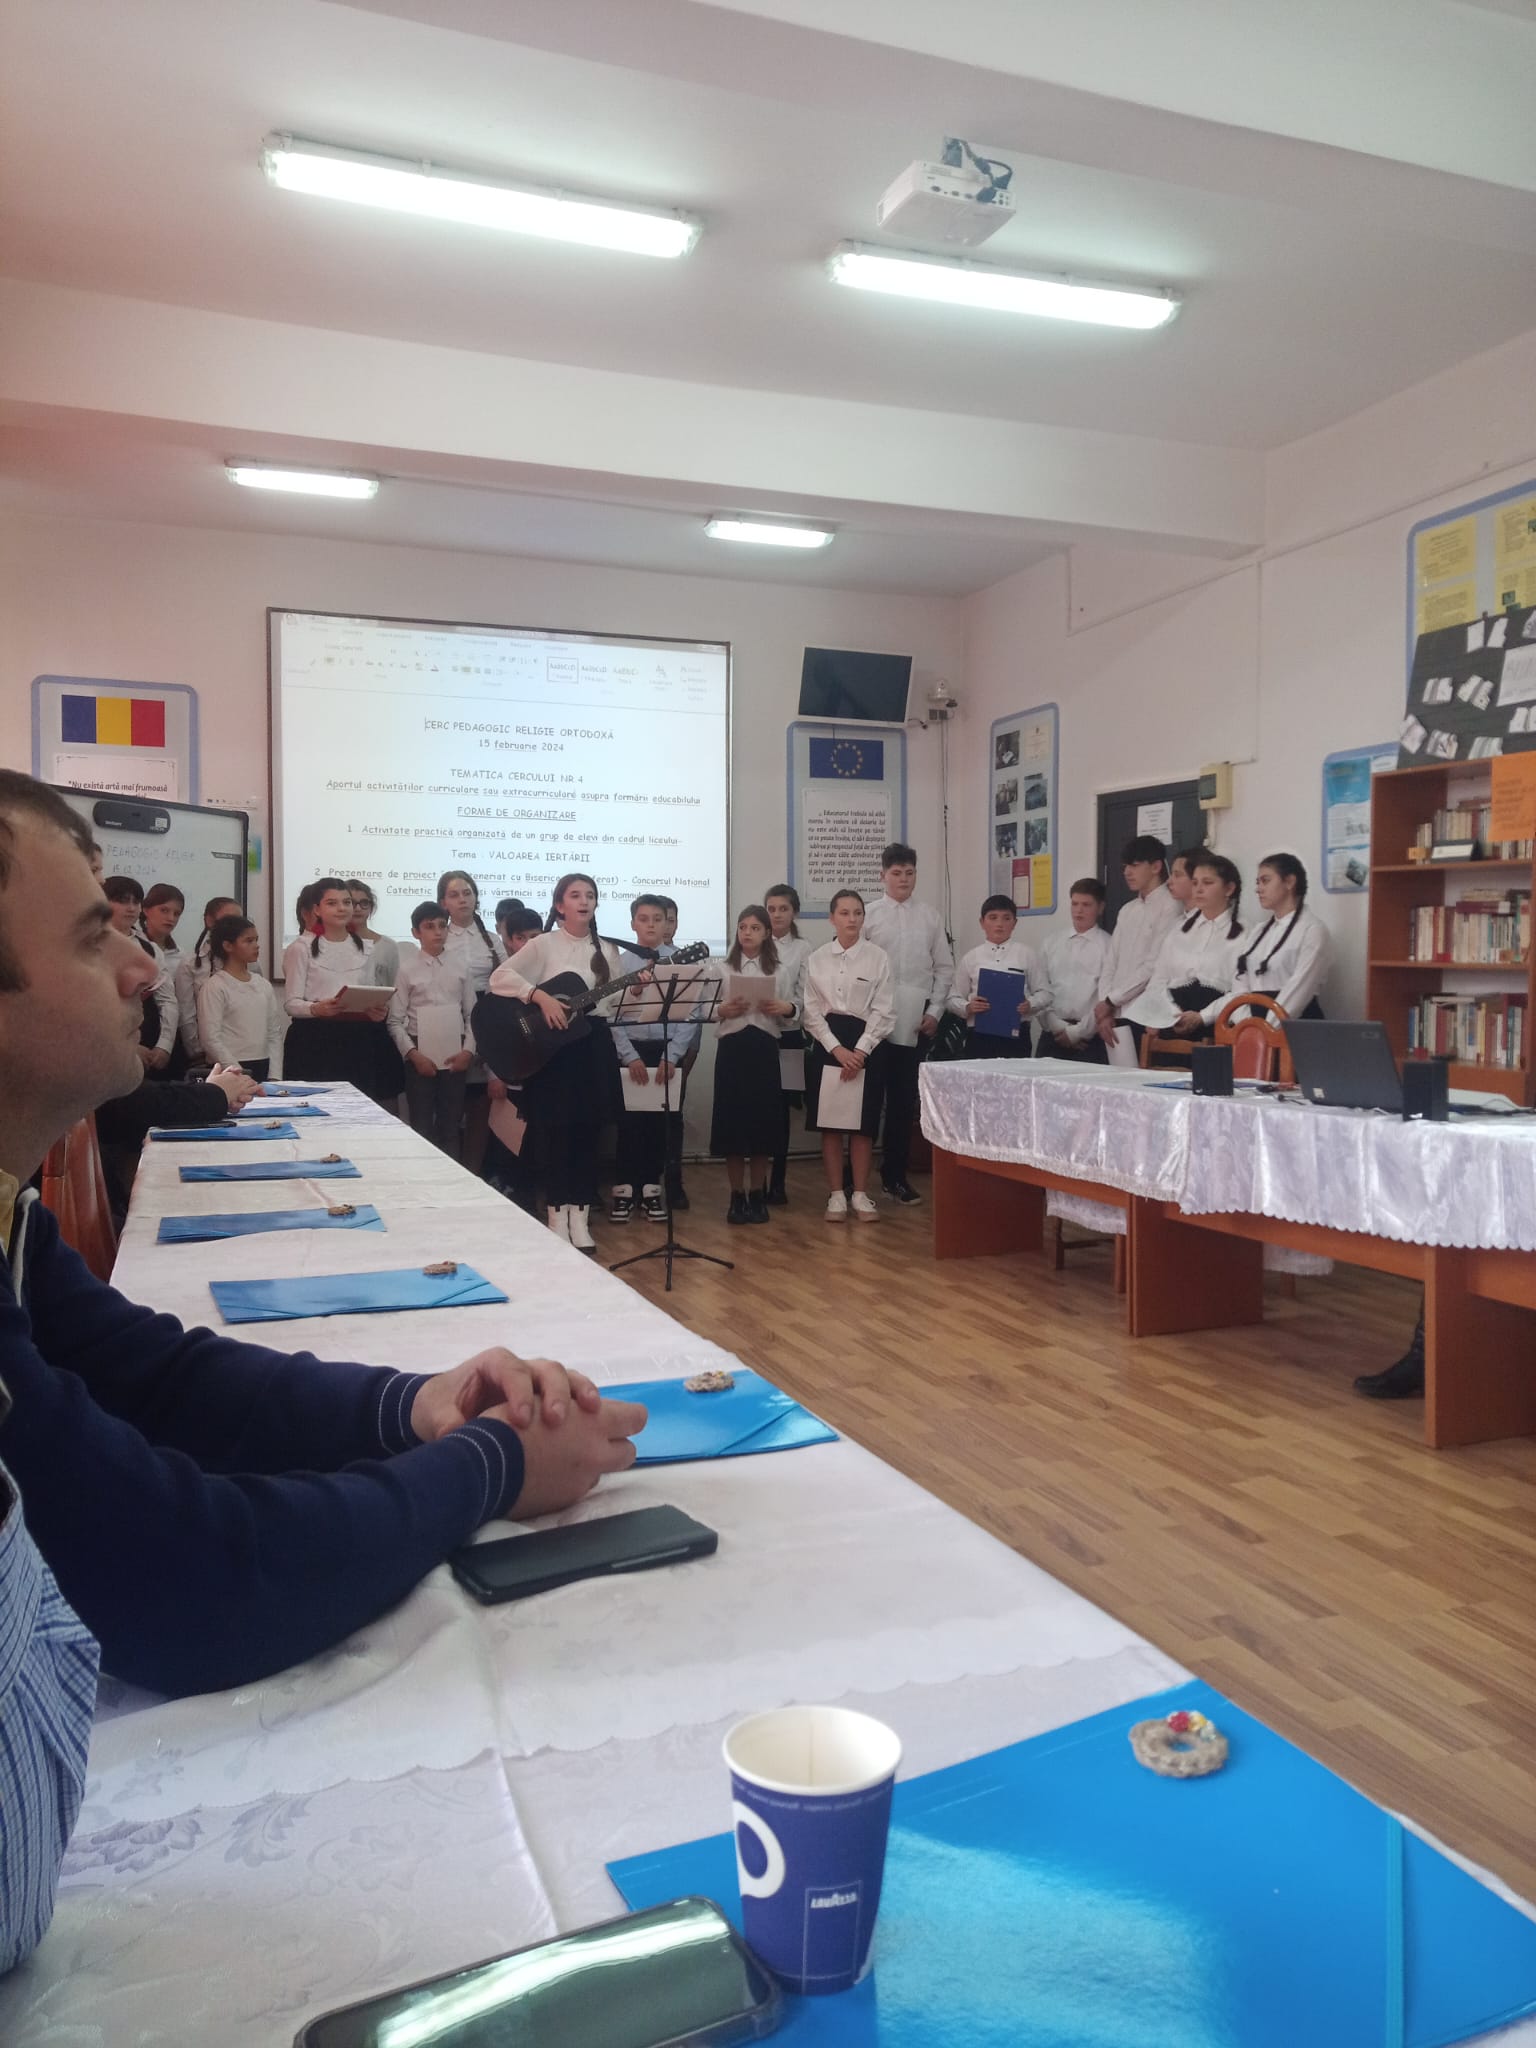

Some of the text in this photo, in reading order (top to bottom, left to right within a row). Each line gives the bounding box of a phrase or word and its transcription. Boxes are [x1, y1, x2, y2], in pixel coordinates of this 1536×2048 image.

[426, 720, 450, 730] CERC
[453, 721, 511, 734] PEDAGOGIC
[515, 725, 555, 736] RELIGIE
[479, 739, 564, 752] 15 februarie 2024
[450, 768, 503, 780] TEMATICA
[508, 771, 555, 783] CERCULUI
[135, 784, 168, 792] frumoasă
[327, 779, 362, 790] Aportul
[428, 784, 479, 795] curriculare
[483, 786, 499, 795] sau
[502, 787, 577, 799] extracurriculare
[581, 791, 609, 801] asupra
[652, 794, 701, 805] educabilului
[457, 806, 577, 820] FORME DE ORGANIZARE
[362, 825, 410, 836] Activitate
[414, 827, 453, 838] practică
[457, 828, 506, 840] organizată
[511, 830, 522, 839] de
[539, 831, 560, 842] grup
[563, 832, 574, 841] de
[577, 832, 598, 842] elevi
[601, 833, 615, 842] din
[618, 834, 645, 844] cadrul
[490, 851, 540, 862] VALOAREA
[329, 868, 383, 879] Prezentare
[388, 869, 399, 878] de
[403, 871, 437, 881] proiect
[631, 875, 671, 886] Concursul
[386, 885, 433, 896] Catehetic
[810, 1890, 858, 1909] LAVAZZA
